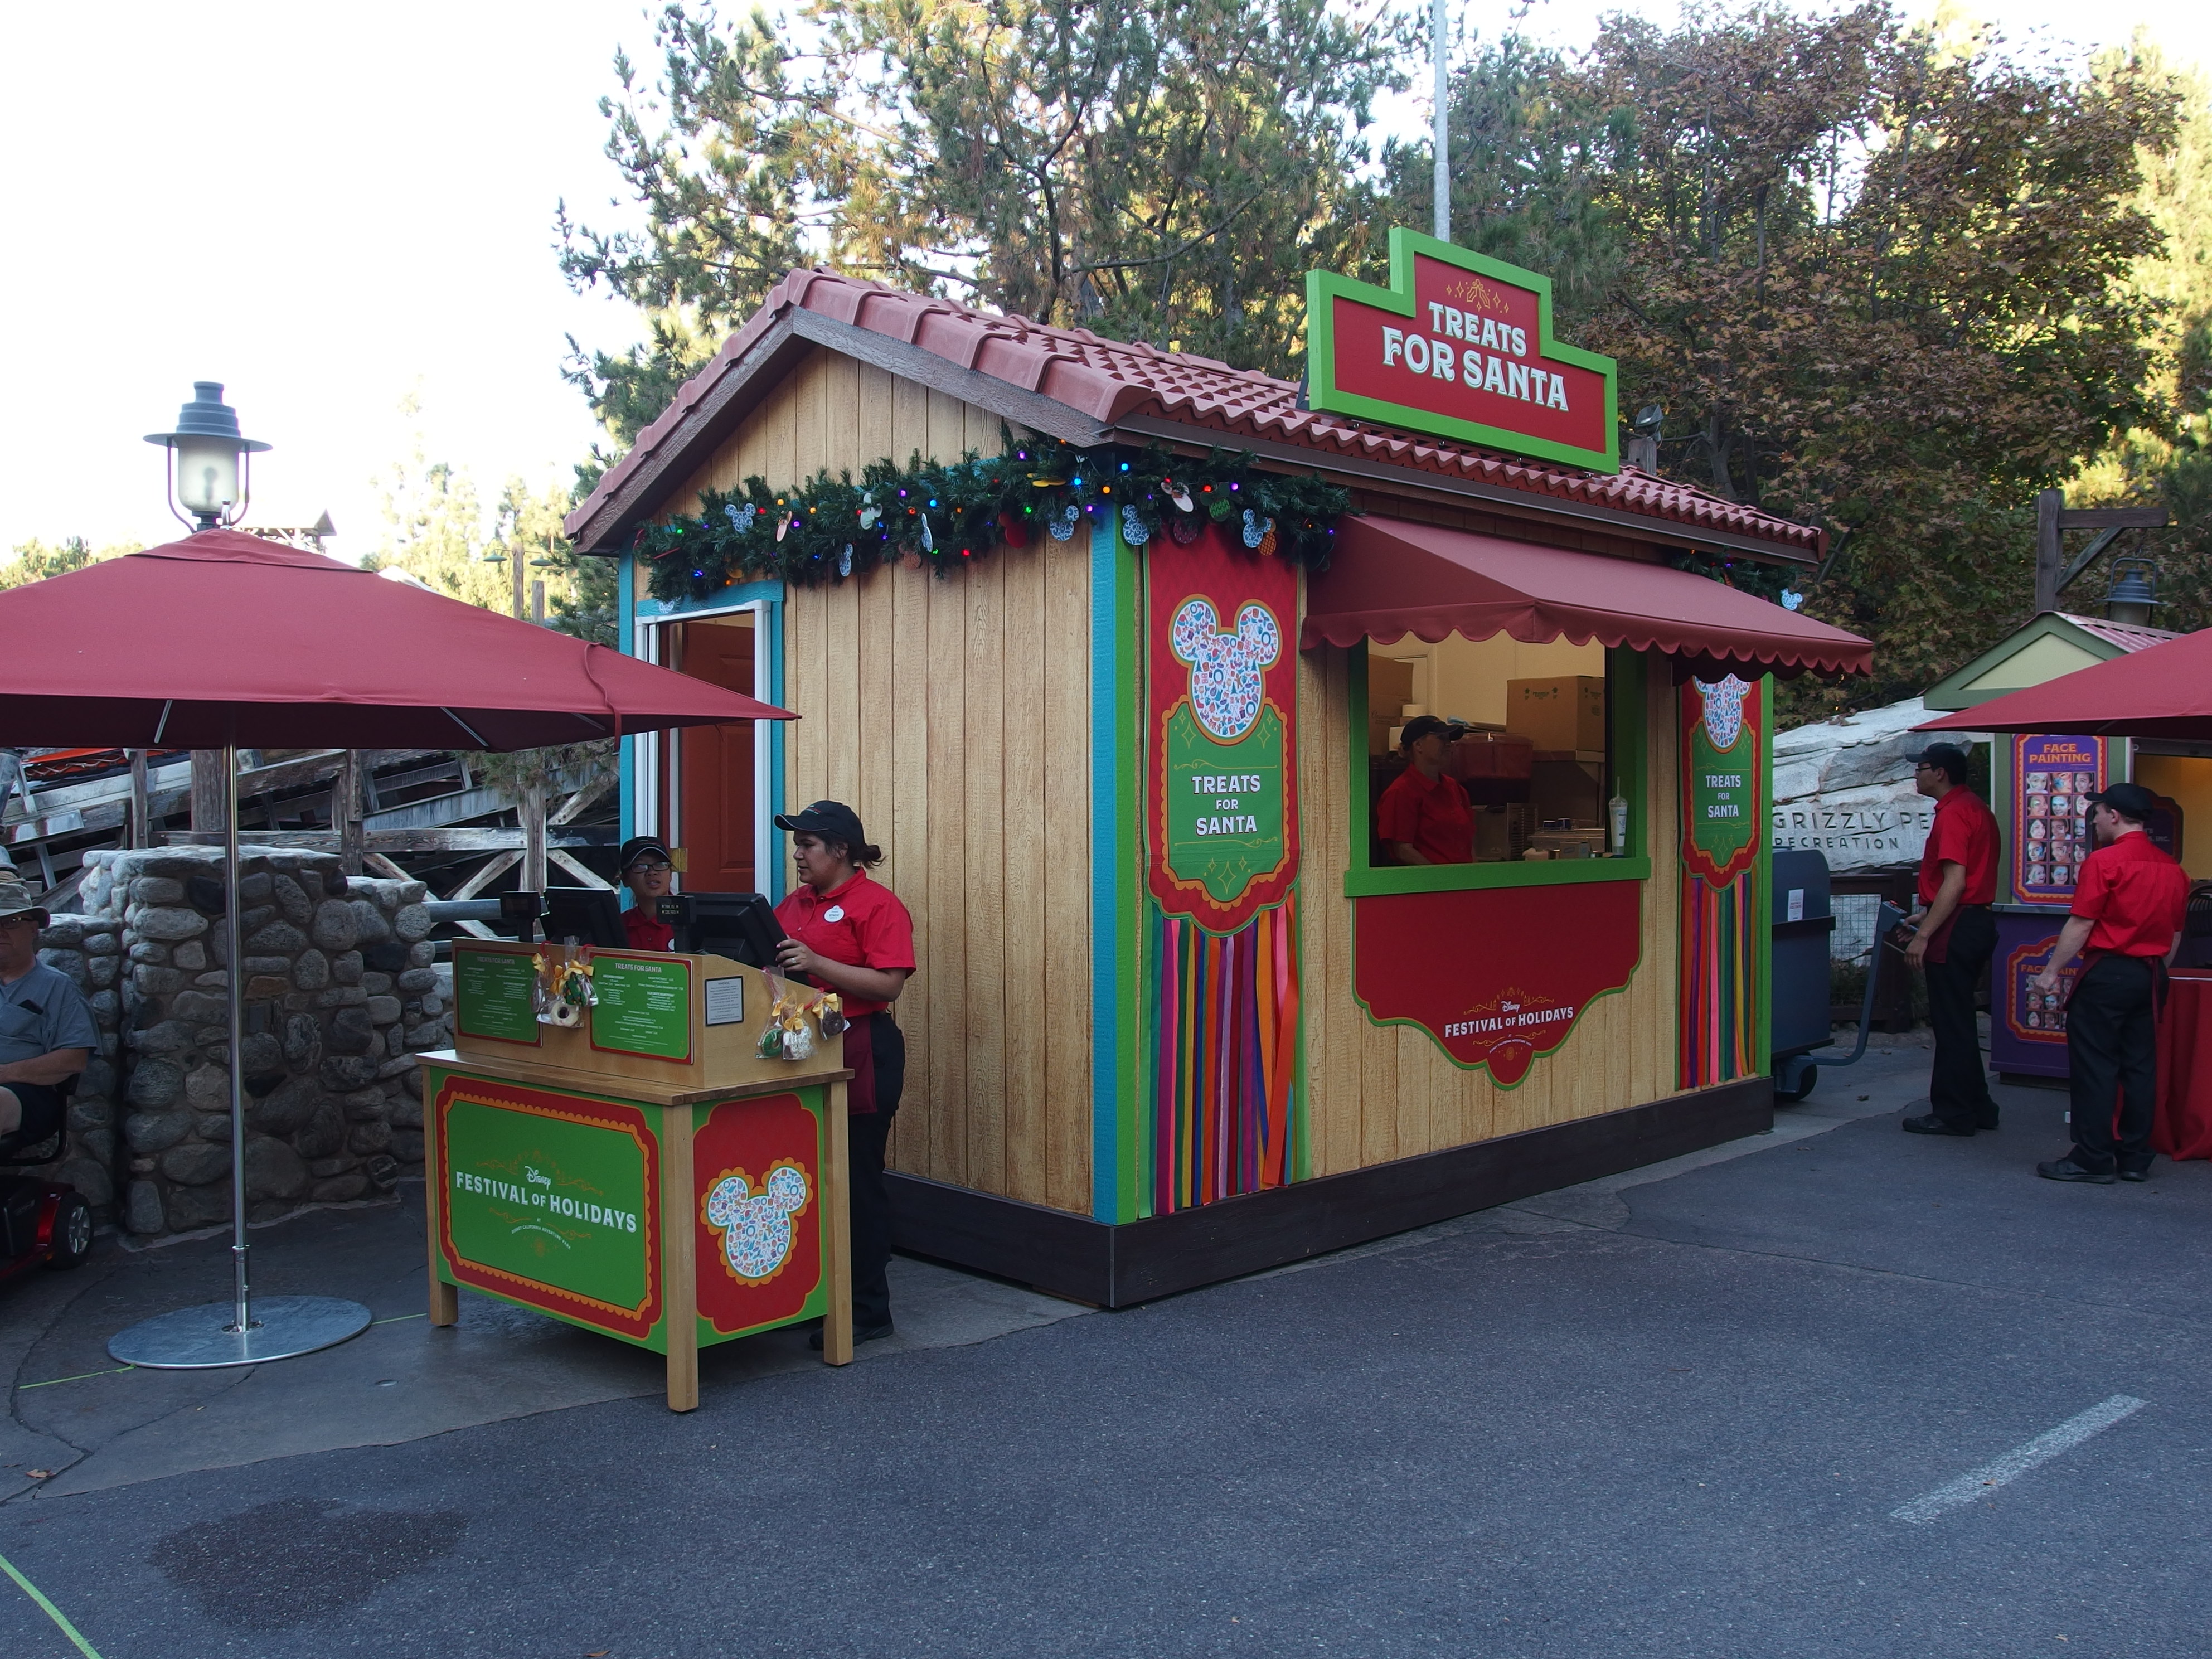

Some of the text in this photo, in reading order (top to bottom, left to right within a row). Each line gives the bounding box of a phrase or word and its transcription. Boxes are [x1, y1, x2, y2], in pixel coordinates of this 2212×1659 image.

[1428, 300, 1527, 357] TREATS
[1382, 326, 1569, 412] FOR SANTA
[2043, 743, 2077, 753] FACE
[2029, 753, 2092, 763] PAINTING
[1191, 775, 1261, 794] TREATS
[1705, 775, 1742, 788] TREATS
[1718, 792, 1730, 801] FOR
[1215, 799, 1239, 811] FOR
[1707, 804, 1739, 818] SANTA
[1196, 815, 1258, 836] SANTA
[1773, 812, 1930, 830] GRIZZLY PE
[1775, 837, 1899, 850] RECREATION
[615, 963, 633, 971] TREATS
[1445, 1006, 1574, 1038] FESTIVAL OF HOLIDAYS
[456, 1171, 637, 1233] FESTIVAL OF HOLIDAYS
